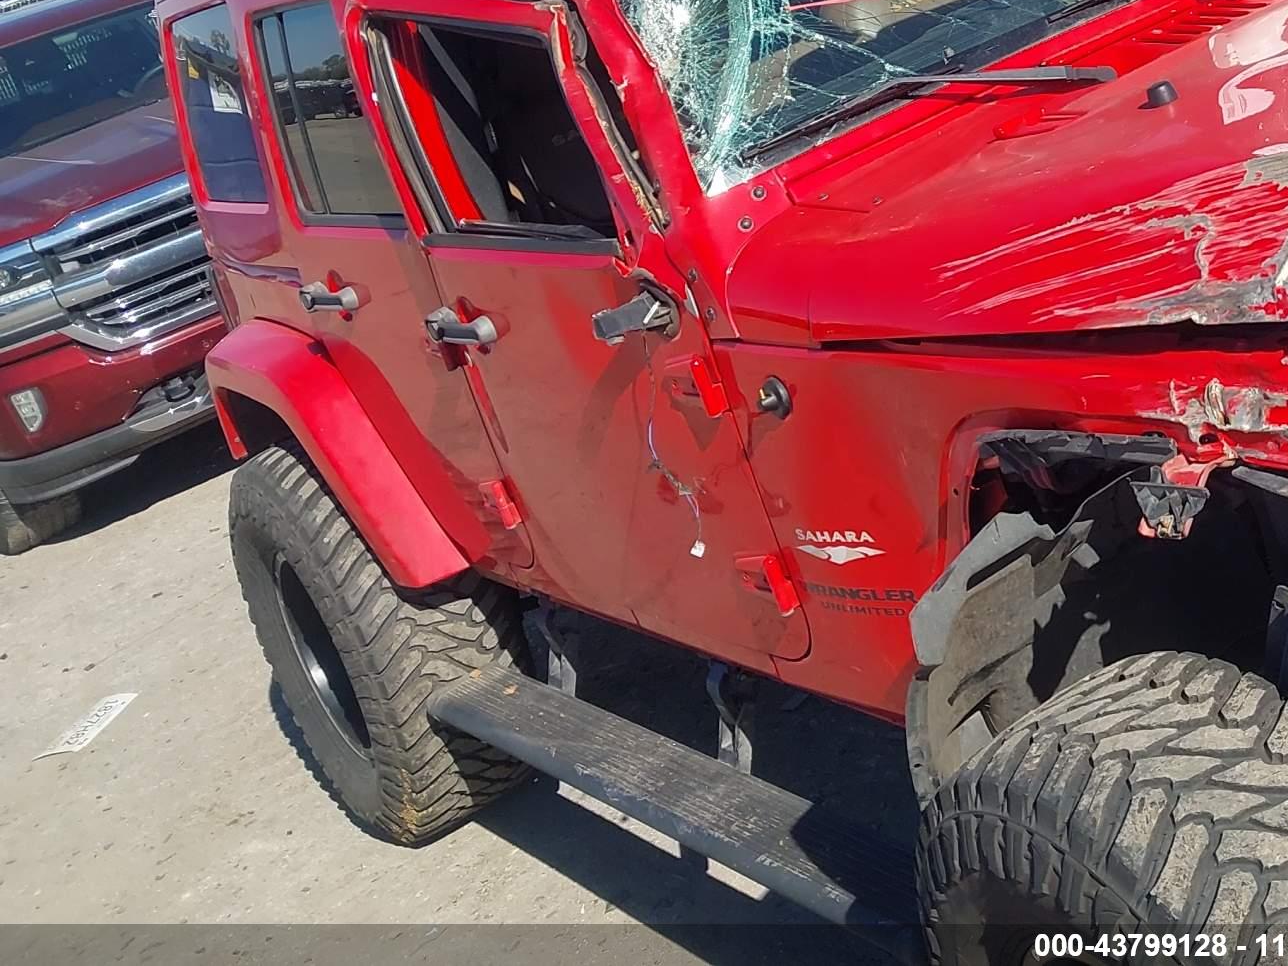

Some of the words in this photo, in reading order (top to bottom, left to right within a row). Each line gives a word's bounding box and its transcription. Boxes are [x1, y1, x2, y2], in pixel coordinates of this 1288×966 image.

[795, 528, 876, 543] SAHARA
[800, 580, 918, 604] WRANGLER
[822, 601, 906, 617] UNLIMITED
